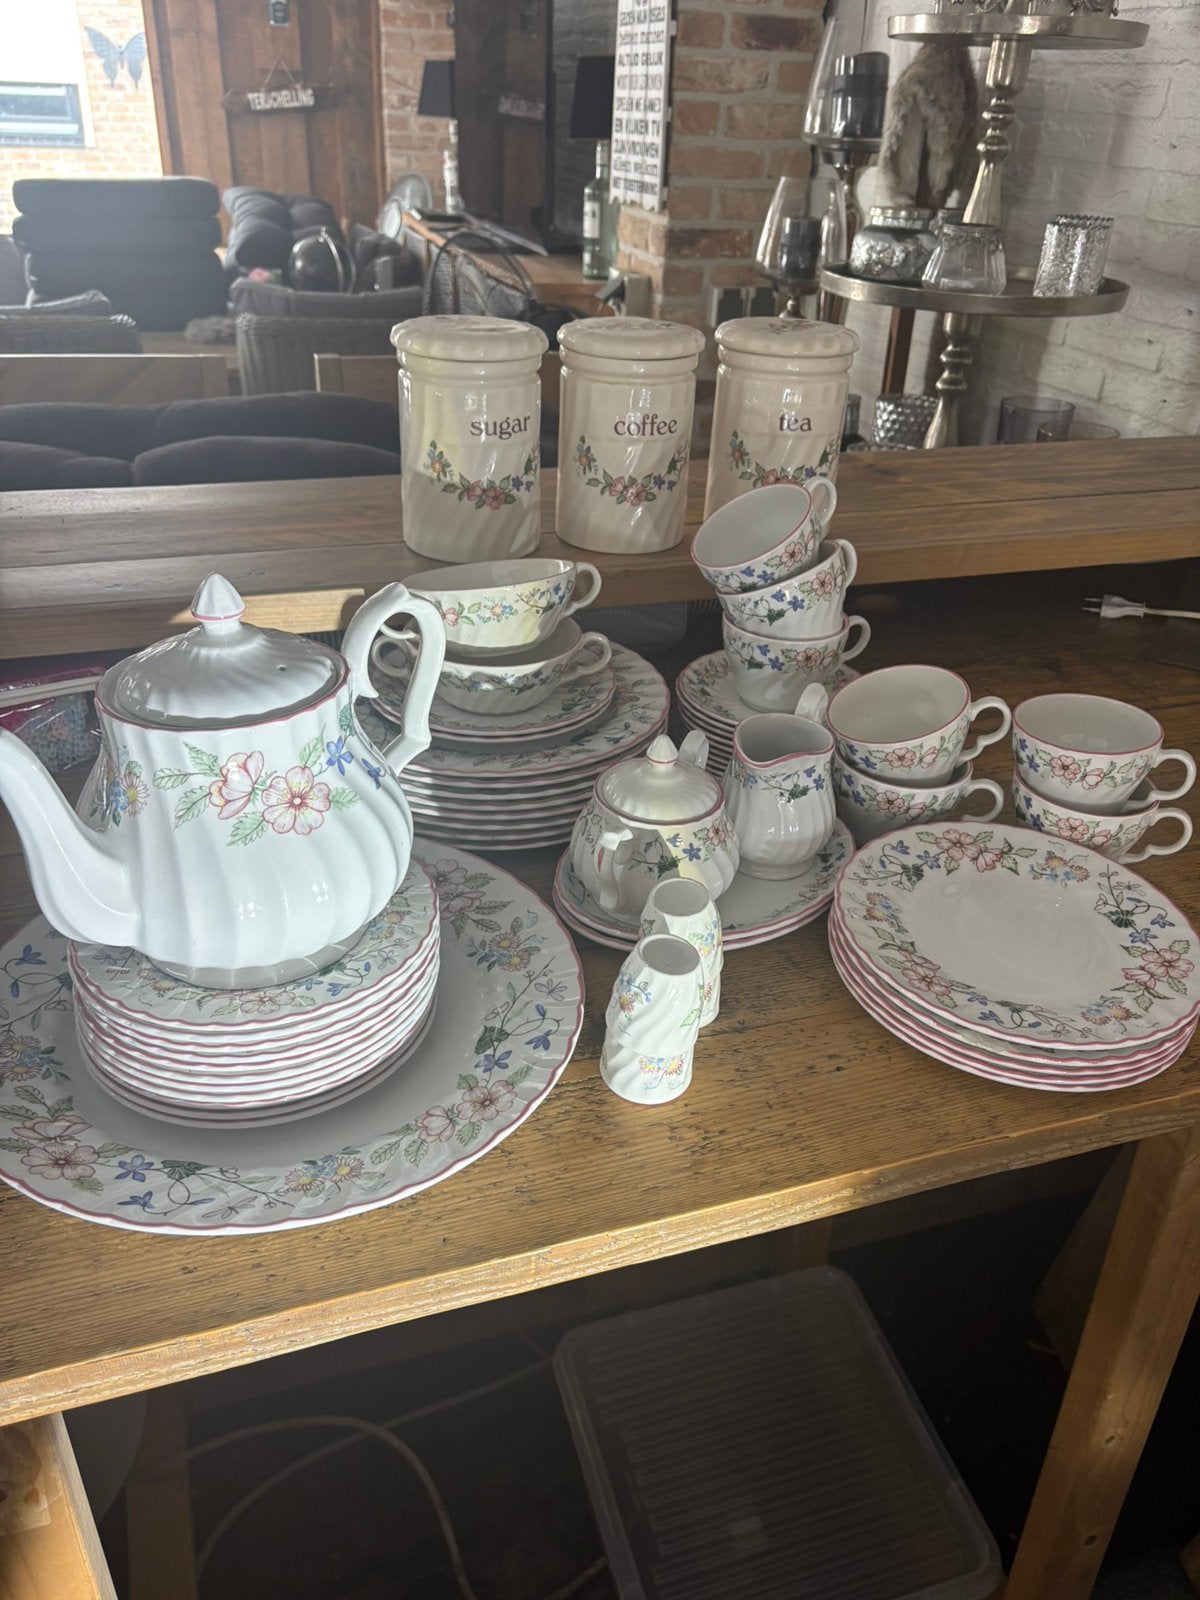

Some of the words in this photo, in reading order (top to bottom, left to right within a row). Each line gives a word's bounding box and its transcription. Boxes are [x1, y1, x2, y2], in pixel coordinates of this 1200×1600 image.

[470, 414, 530, 440] sugar
[614, 414, 677, 437] coffee
[779, 414, 813, 433] tea
